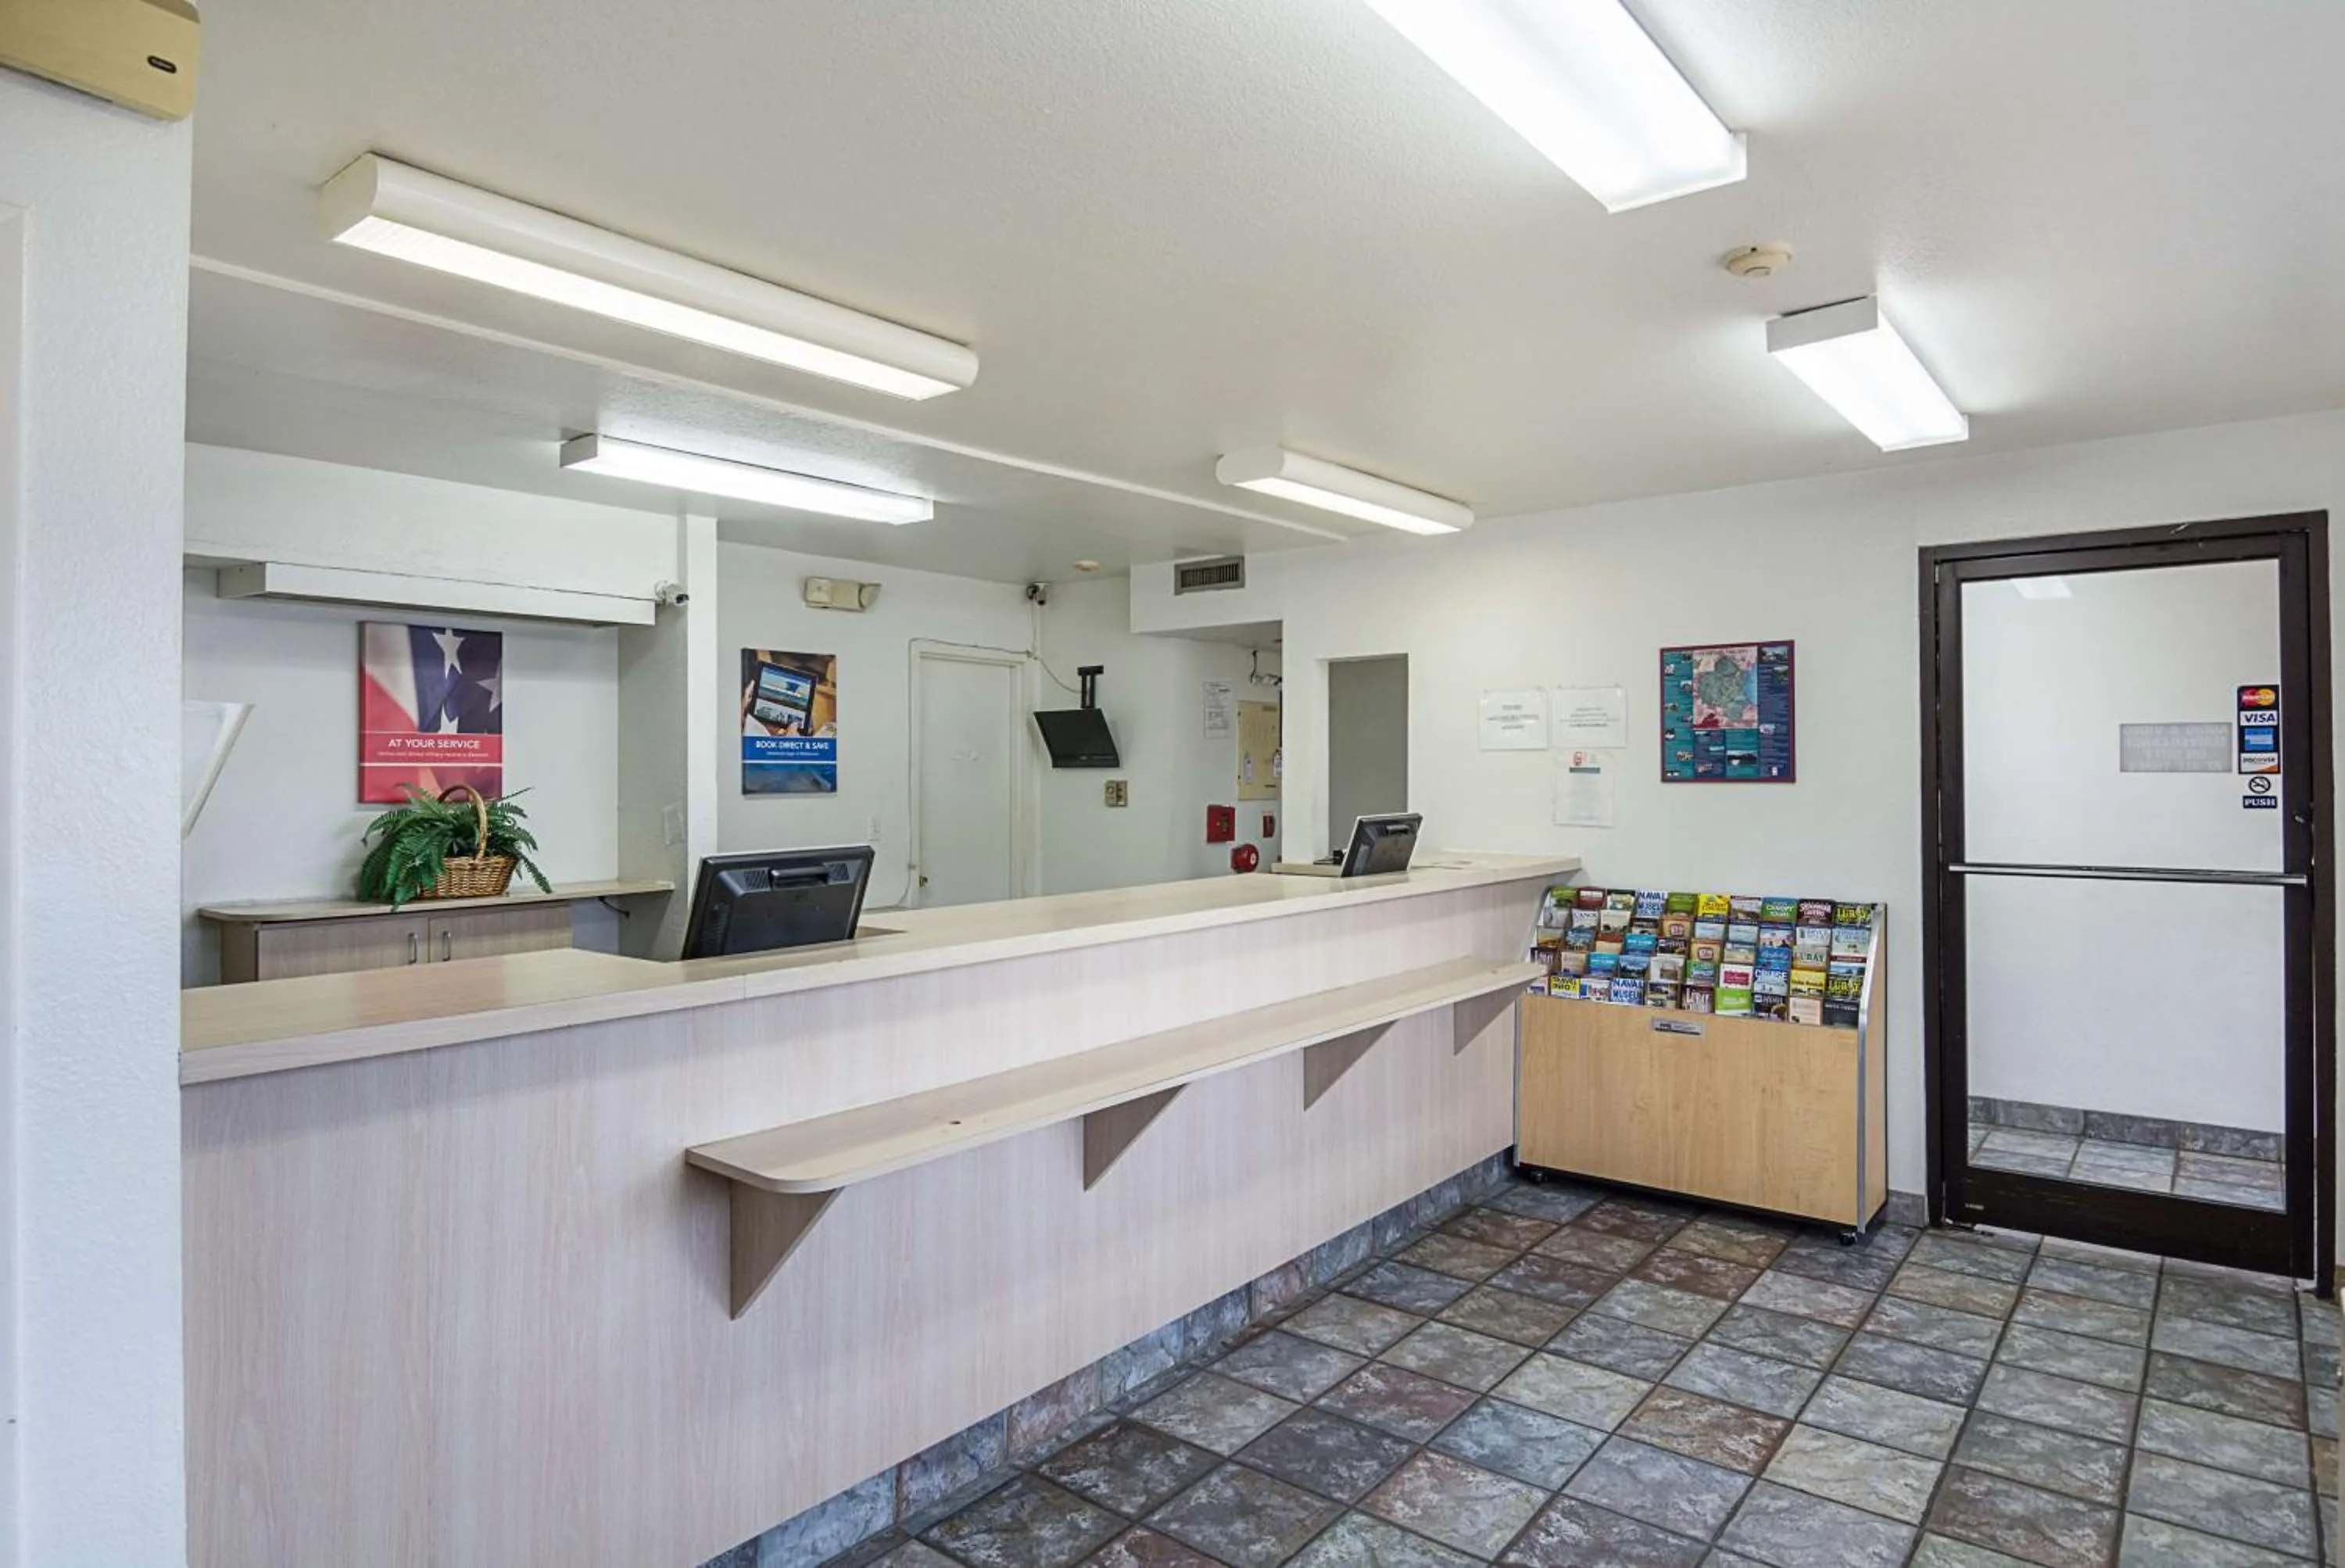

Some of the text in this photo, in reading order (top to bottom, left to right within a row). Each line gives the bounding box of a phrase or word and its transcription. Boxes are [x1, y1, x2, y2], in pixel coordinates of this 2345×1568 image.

[2245, 713, 2275, 723] VISA
[388, 739, 482, 750] AT YOUR SERVICE
[756, 740, 777, 749] BOOK
[779, 741, 804, 750] DIRECT
[2244, 797, 2276, 806] PUSH
[1613, 979, 1643, 989] NAVAL
